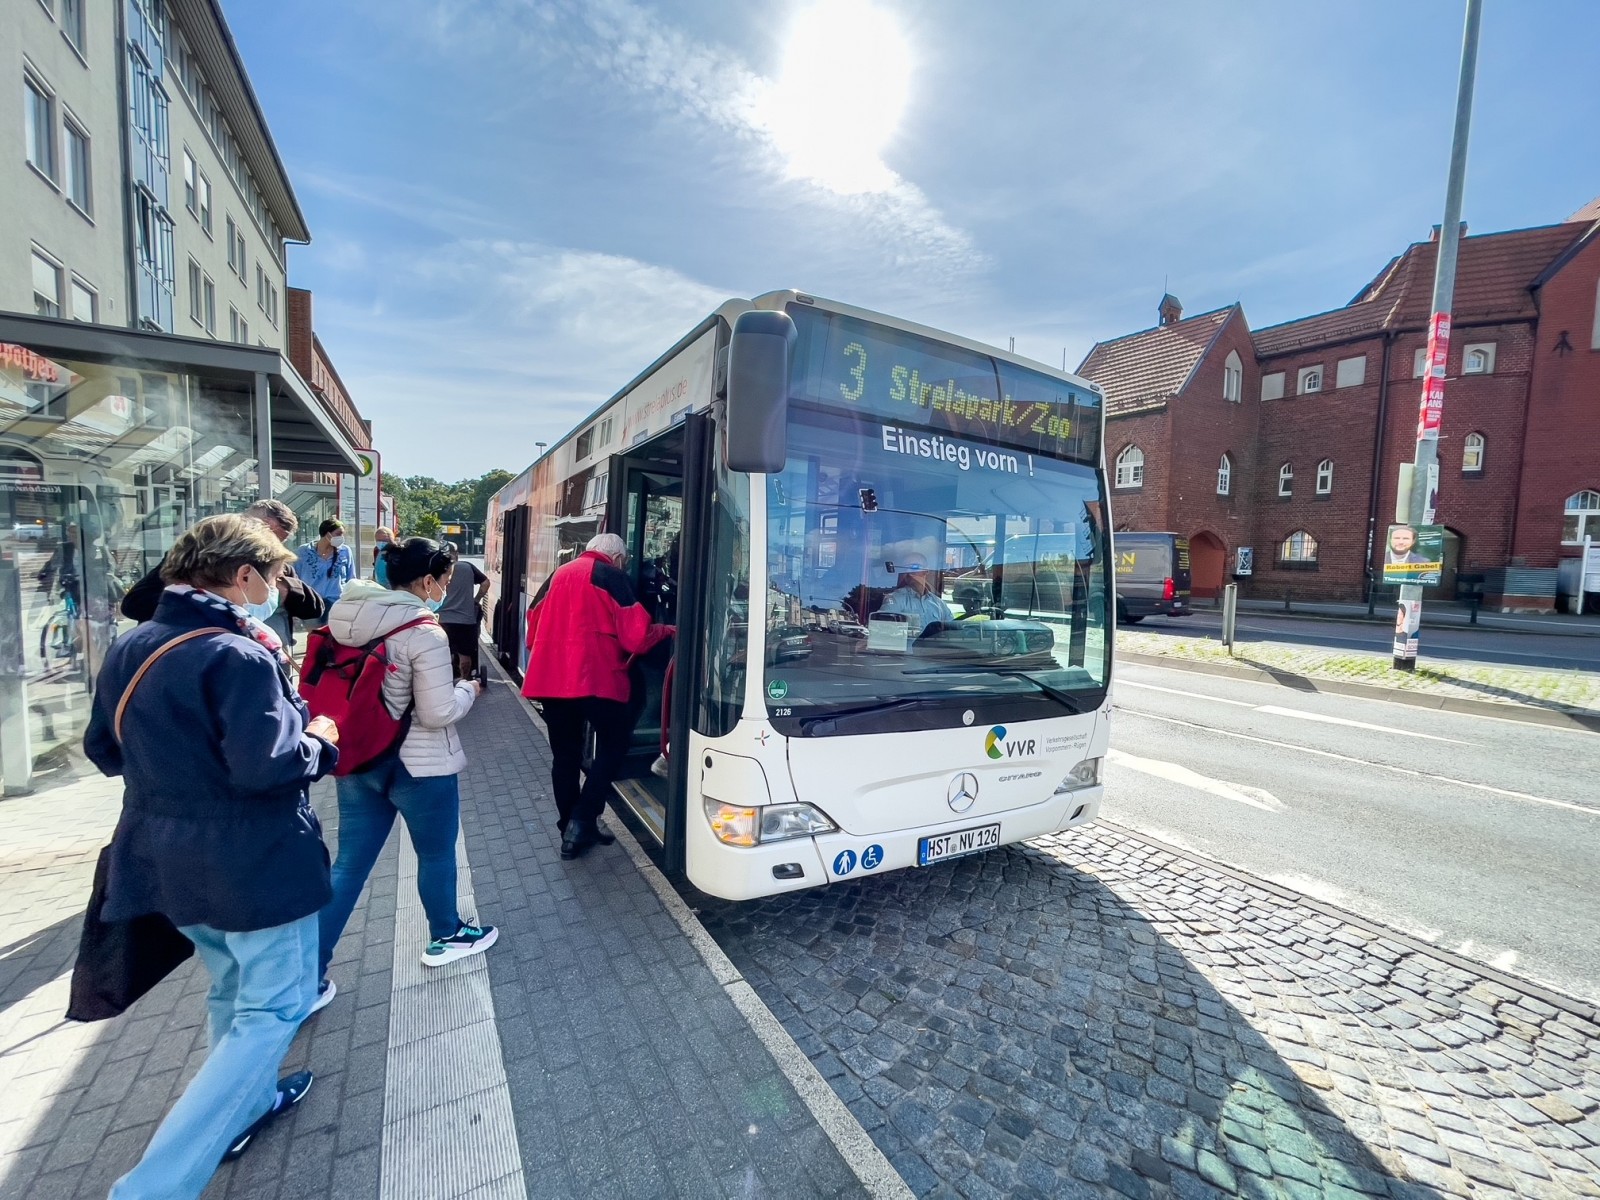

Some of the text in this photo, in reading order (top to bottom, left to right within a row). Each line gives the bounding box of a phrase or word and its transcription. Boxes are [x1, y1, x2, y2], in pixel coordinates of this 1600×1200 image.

[840, 341, 867, 401] 3
[890, 365, 1071, 439] Strelapark/Zoo
[882, 425, 1034, 477] Einstieg vorn !
[775, 708, 791, 717] 2126
[1006, 739, 1036, 758] VVR
[928, 836, 951, 858] HST
[959, 831, 975, 850] NV
[977, 827, 997, 847] 126
